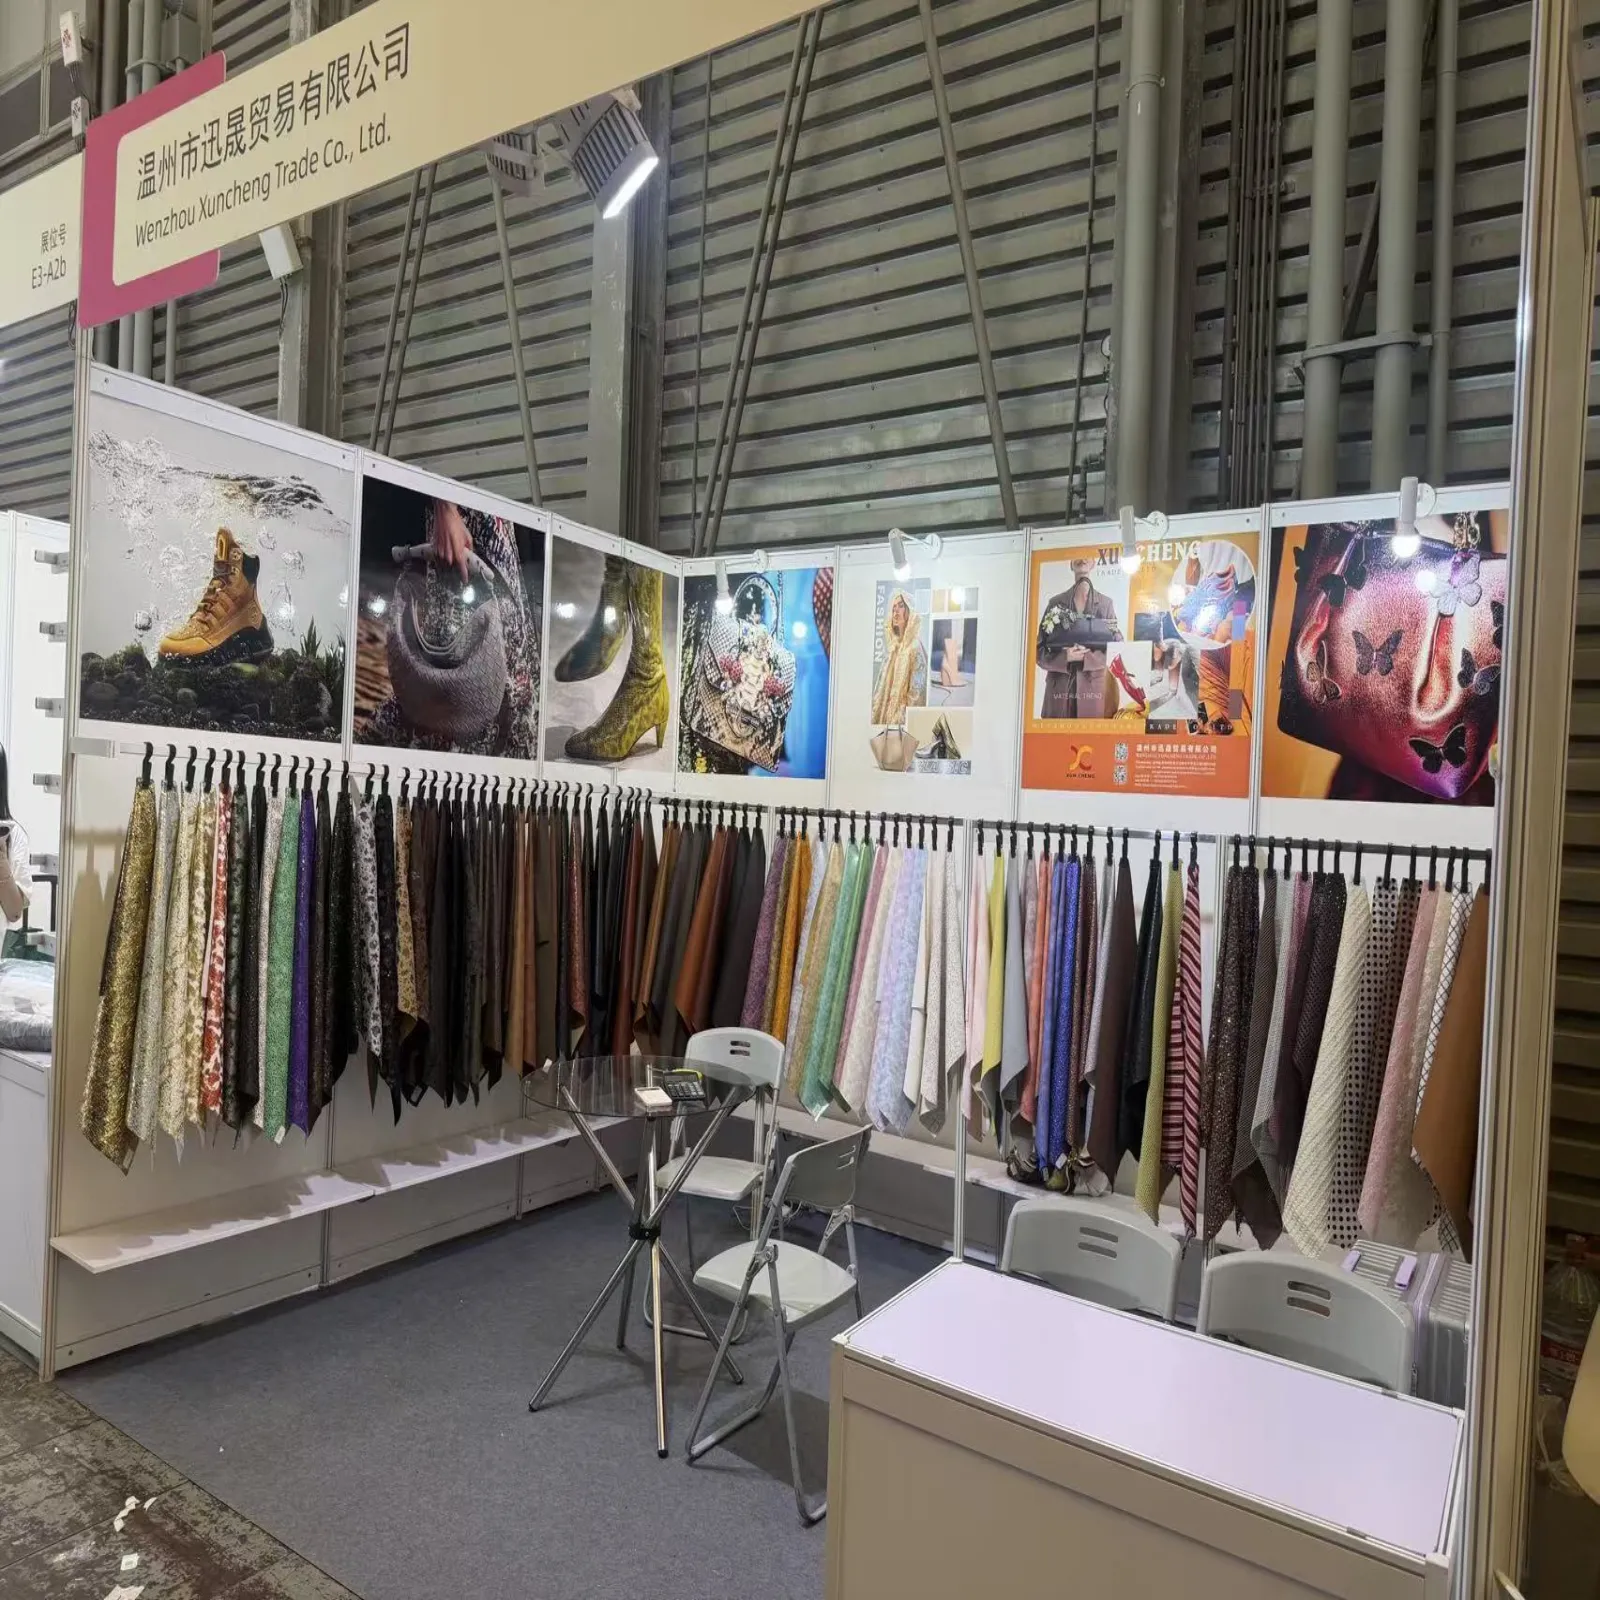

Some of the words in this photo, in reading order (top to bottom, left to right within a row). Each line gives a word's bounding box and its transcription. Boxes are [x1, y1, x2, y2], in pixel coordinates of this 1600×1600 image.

[137, 22, 410, 201] 温州市迅晟贸易有限公司
[136, 206, 195, 247] Wenzhou
[199, 172, 271, 222] Xuncheng
[275, 147, 319, 188] Trade
[323, 138, 353, 164] Co.,
[359, 112, 391, 153] Ltd.
[32, 255, 67, 289] E3-A2b
[41, 223, 67, 254] 展位号
[874, 585, 886, 662] FASHION
